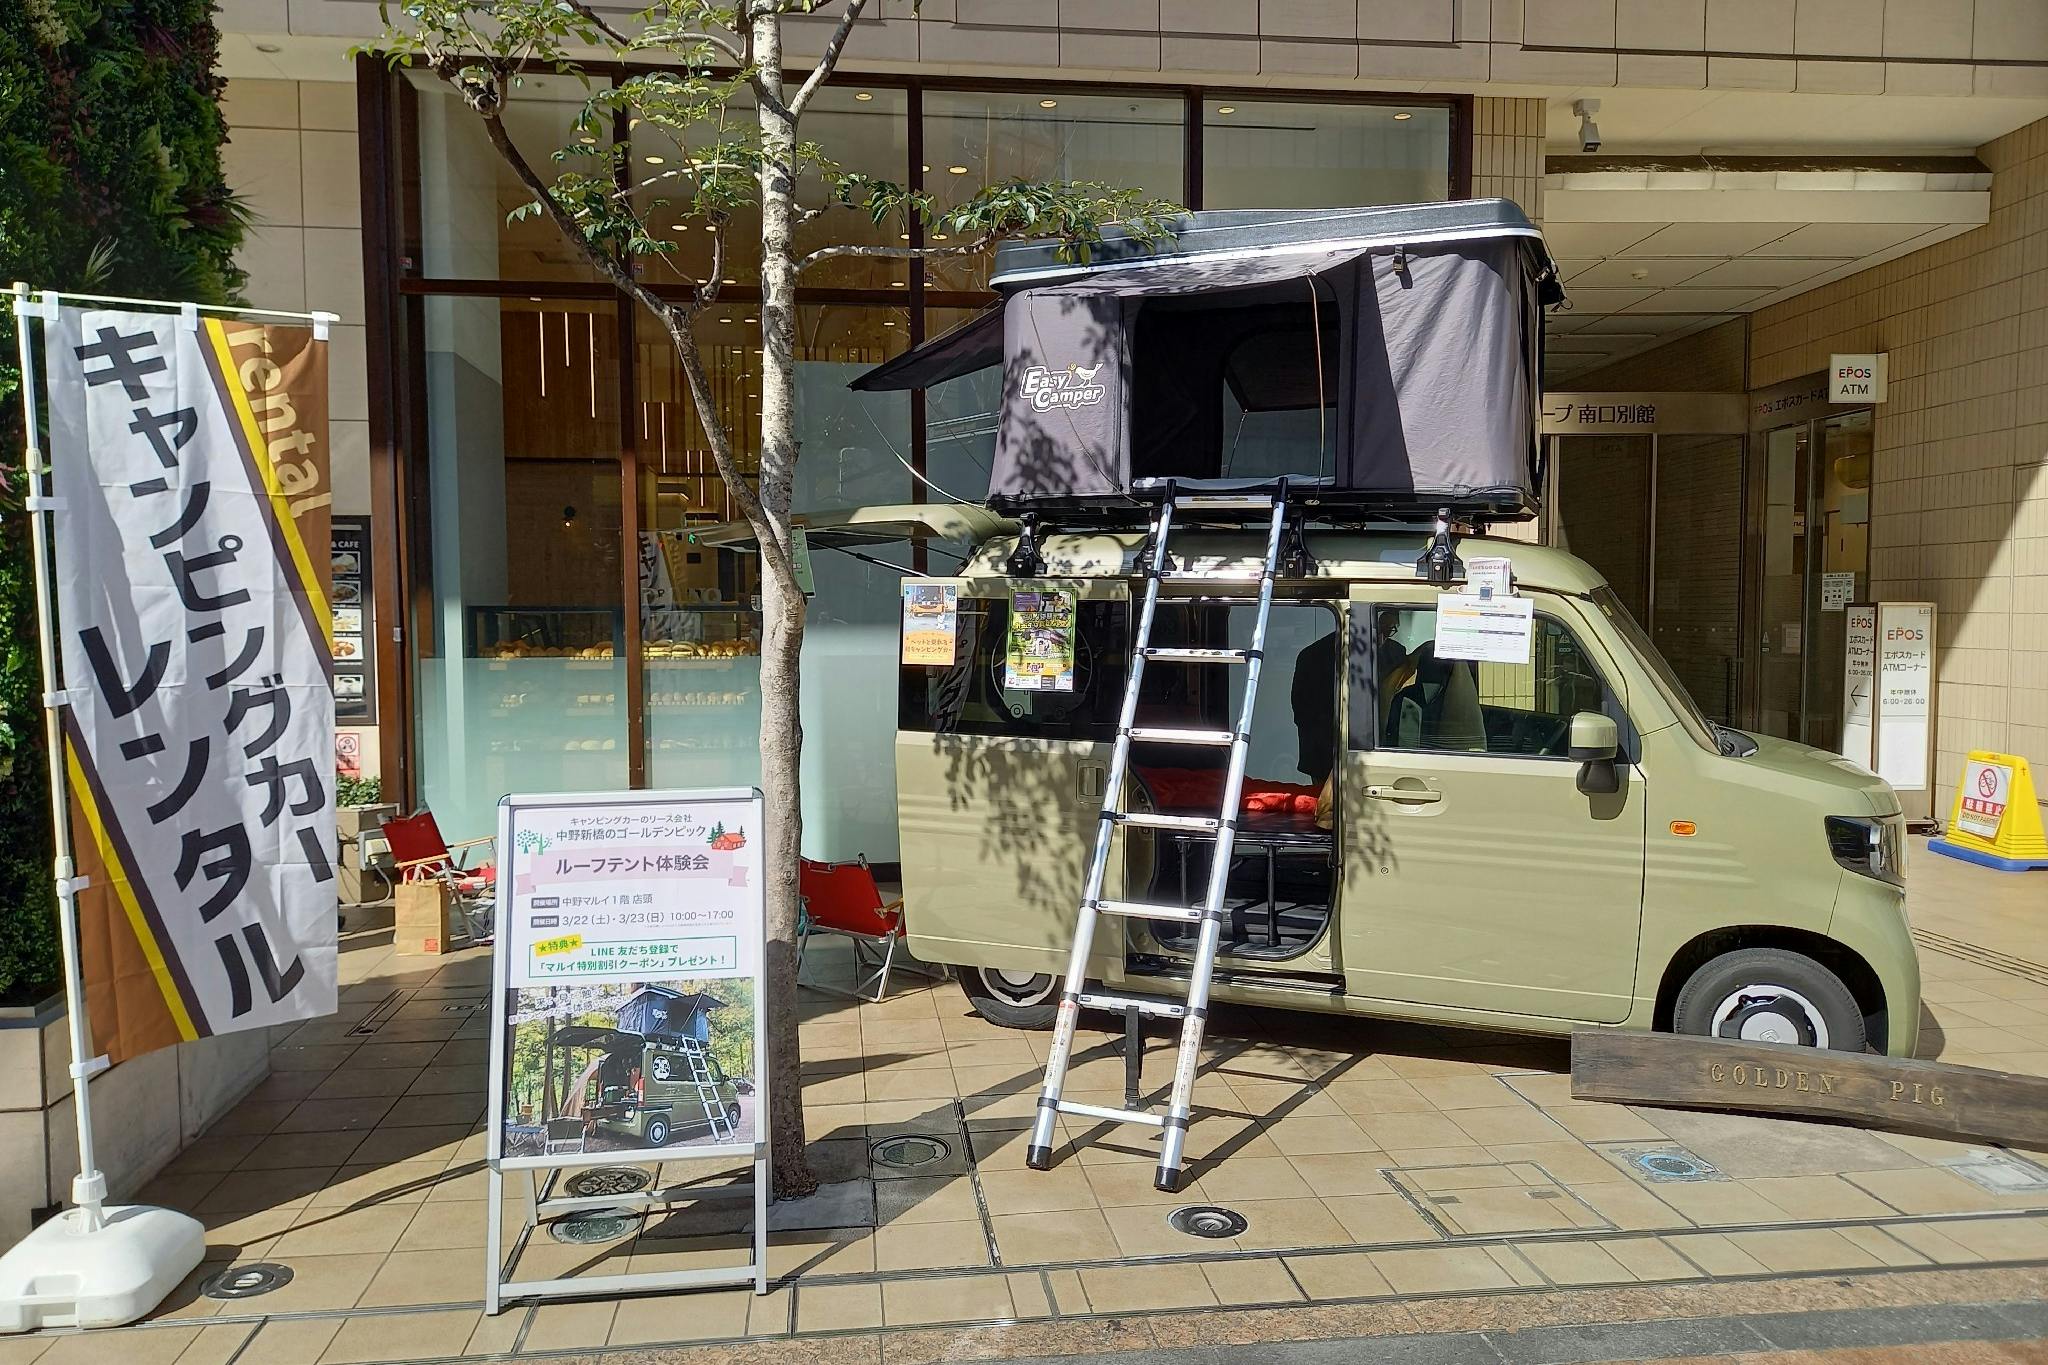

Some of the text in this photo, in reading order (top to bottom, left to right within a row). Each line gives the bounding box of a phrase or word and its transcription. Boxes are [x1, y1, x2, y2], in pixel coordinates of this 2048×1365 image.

[1838, 366, 1872, 379] EPOS
[1024, 370, 1068, 394] Easy
[1840, 384, 1869, 395] ATM
[1035, 388, 1102, 408] Camper
[1578, 404, 1656, 425] 南口別館
[226, 326, 331, 520] rental
[342, 541, 359, 550] CAFE
[74, 326, 334, 883] キャンピングカー
[1851, 615, 1872, 628] EPOS
[1887, 627, 1924, 640] EPOS
[1884, 651, 1926, 660] エポスカード
[1882, 663, 1927, 672] ATMコーナー
[79, 626, 305, 1018] レンタル
[570, 813, 692, 826] キャンピングカーのリース会社
[555, 853, 709, 875] ルーフテント体験会
[591, 944, 678, 956] LINE 友だち登録で
[1711, 1063, 1945, 1106] GOLDEN PIG
